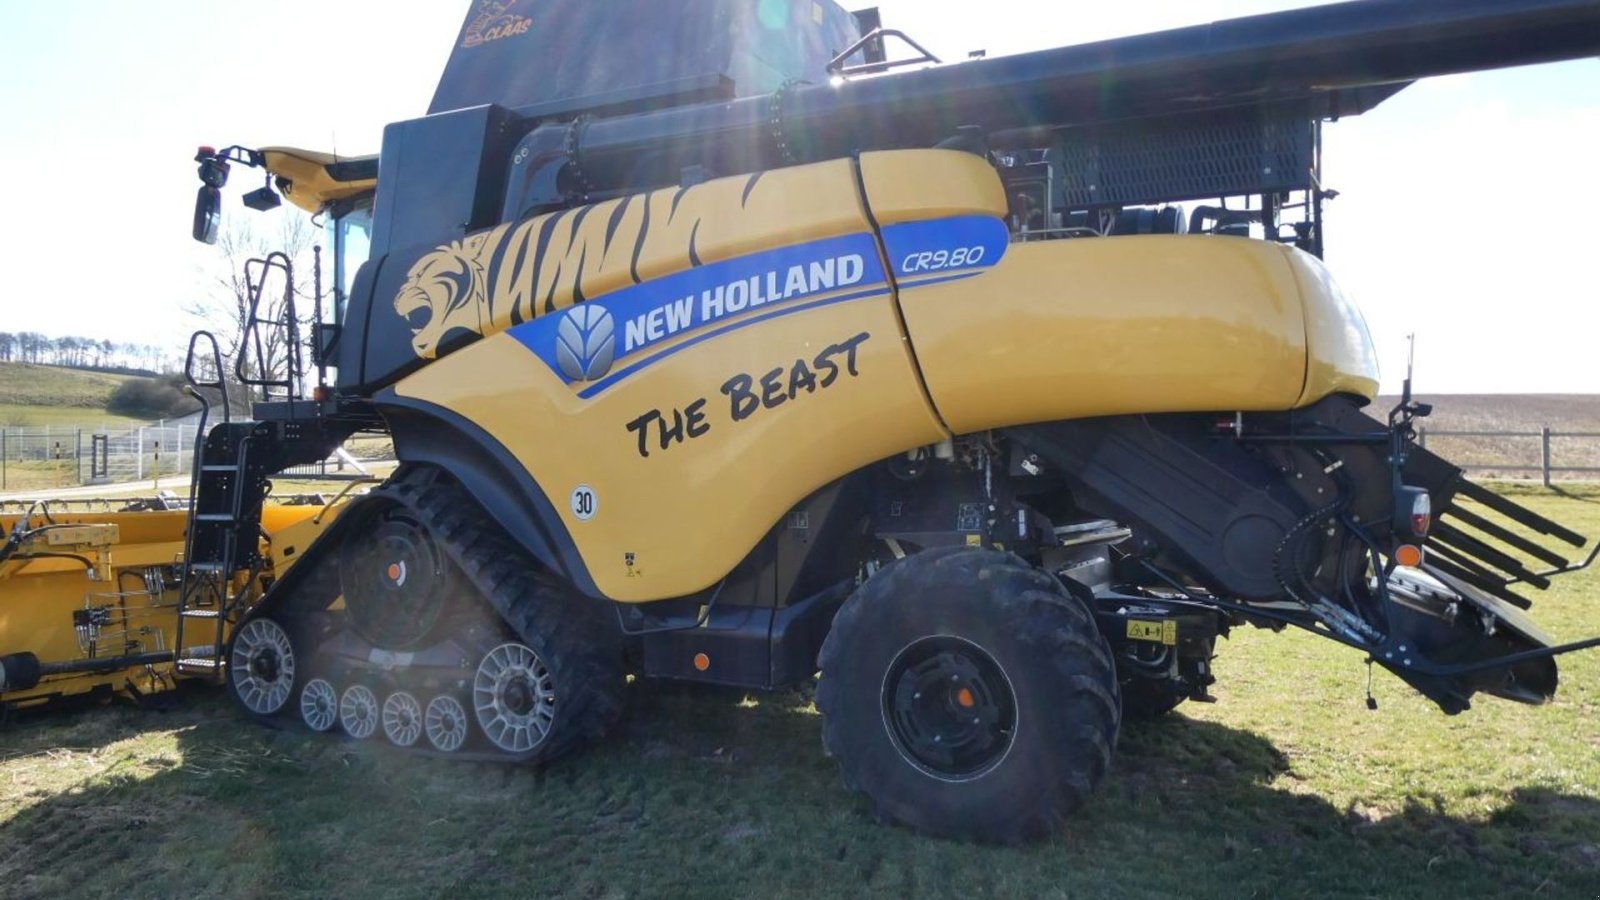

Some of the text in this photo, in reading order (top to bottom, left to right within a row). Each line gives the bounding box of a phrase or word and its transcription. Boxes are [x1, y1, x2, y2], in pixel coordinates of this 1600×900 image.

[484, 18, 532, 41] CLAAS
[902, 245, 985, 274] CR9.80
[624, 254, 864, 352] NEW HOLLAND
[626, 332, 870, 458] THE BEAST
[575, 491, 593, 515] 30
